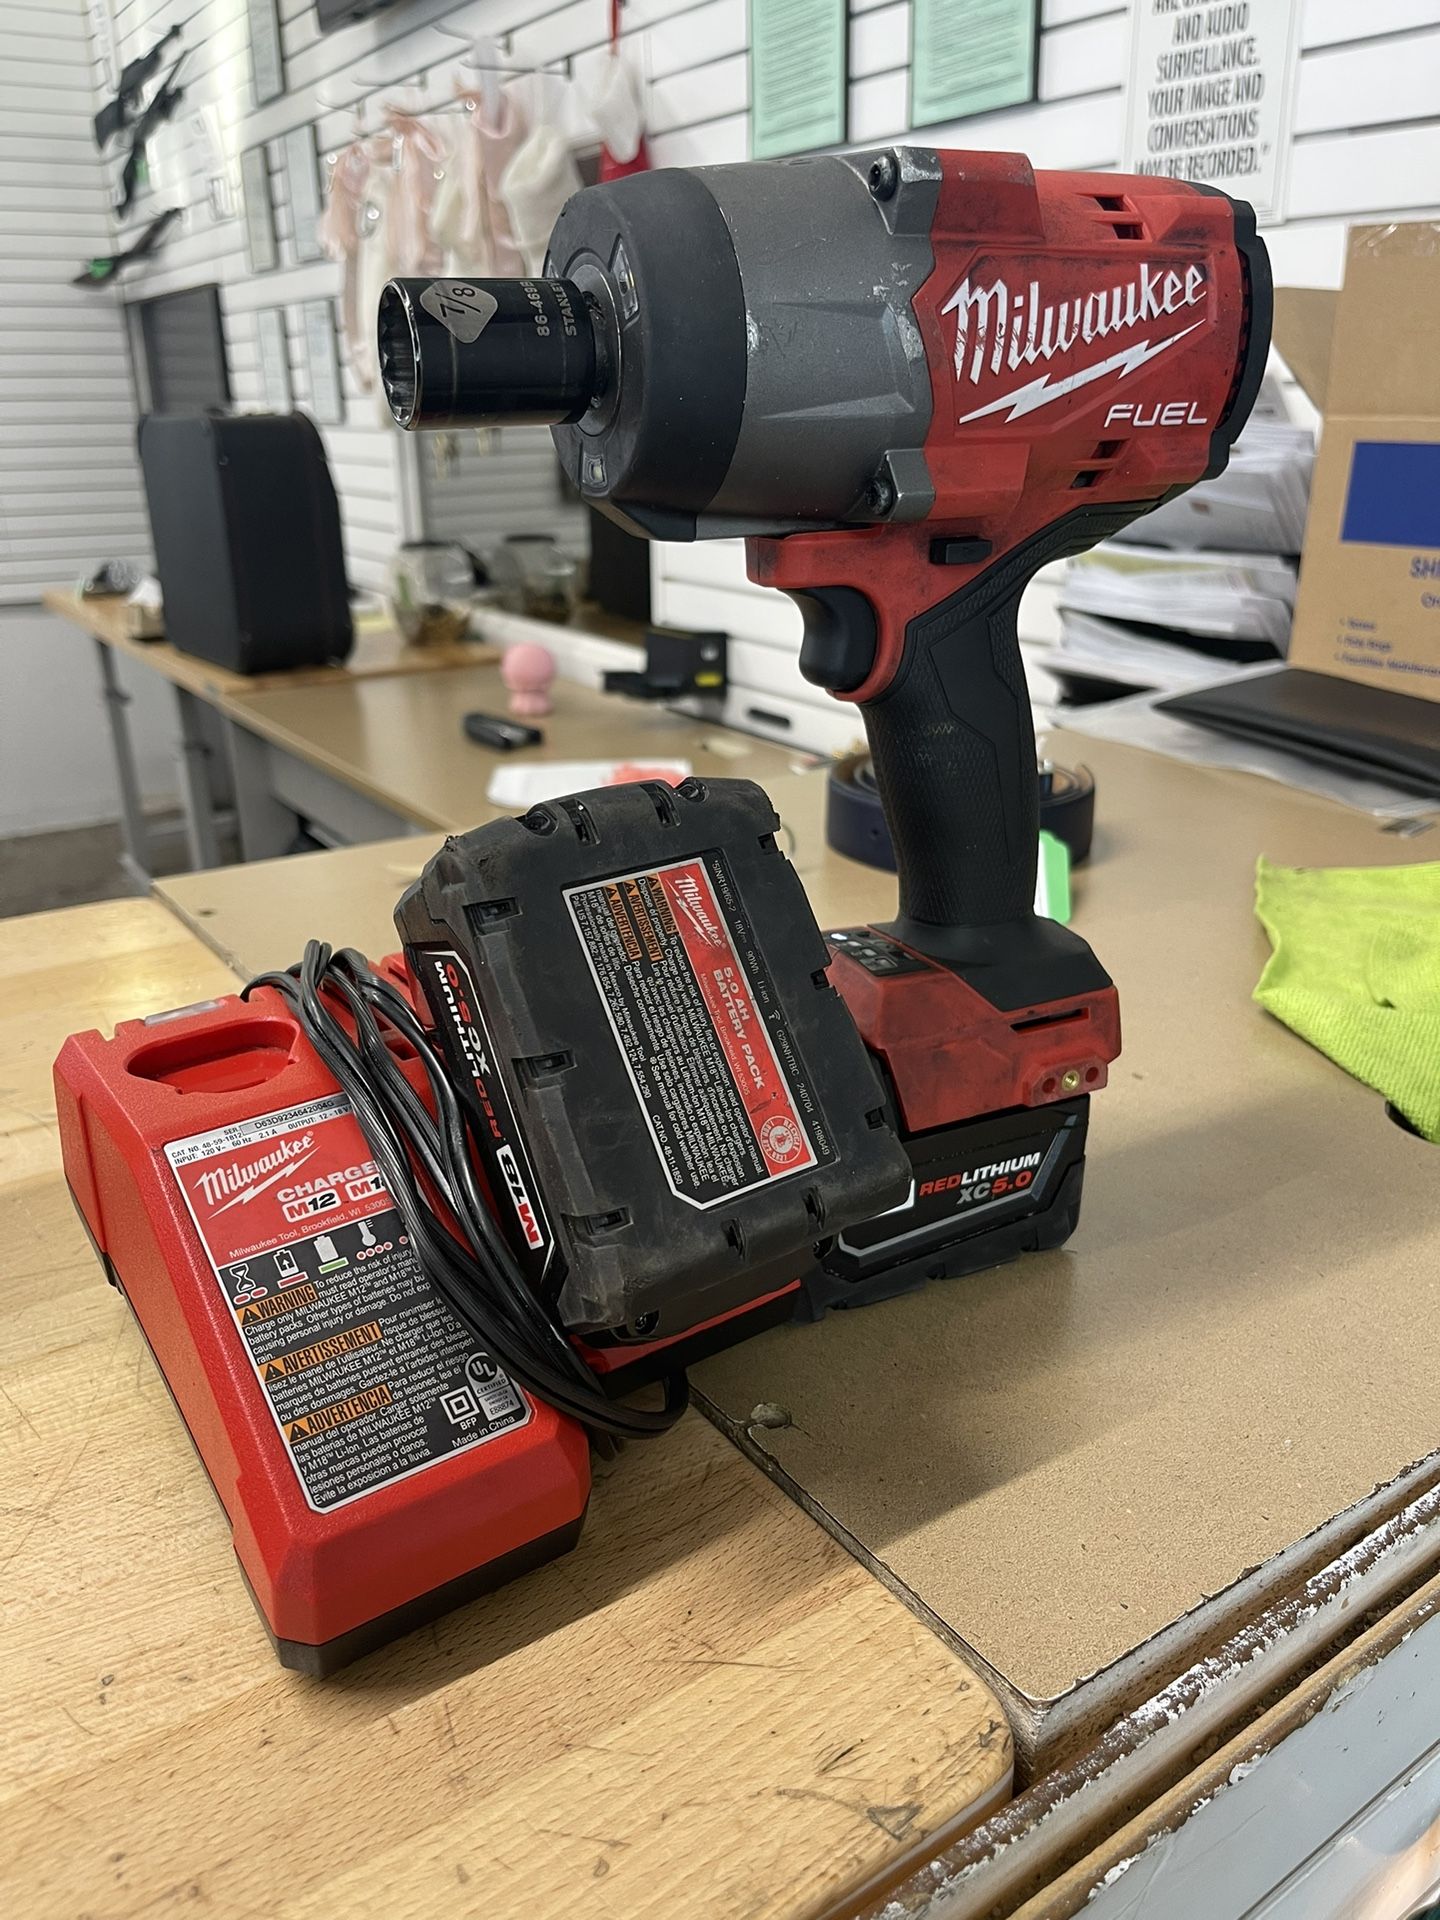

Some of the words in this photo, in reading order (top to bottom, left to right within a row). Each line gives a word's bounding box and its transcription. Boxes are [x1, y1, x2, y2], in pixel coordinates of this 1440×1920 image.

[1187, 78, 1231, 112] IMAGE
[1148, 109, 1259, 153] CONVERSATIONS
[435, 286, 481, 318] 7/8
[550, 281, 577, 336] STANLEY
[941, 263, 1207, 385] Milwaukee
[1104, 402, 1207, 428] FUEL
[610, 898, 640, 957] ADVERTENCIA
[628, 893, 661, 959] AVERTISSEMENT
[651, 887, 676, 932] WARNING
[669, 935, 677, 944] To
[673, 945, 686, 970] reduce
[682, 971, 691, 983] the
[687, 984, 698, 997] risk
[723, 966, 739, 993] 5.0
[734, 997, 749, 1020] AH
[446, 963, 492, 1078] XC5.0
[638, 878, 652, 907] Dispose
[649, 908, 658, 916] of
[664, 948, 678, 975] Charge
[674, 976, 684, 992] only
[680, 992, 692, 1007] with
[686, 1008, 710, 1056] MILWAUKEE
[713, 1080, 733, 1121] Lithium-Ion
[729, 1122, 745, 1158] chargers.
[692, 998, 701, 1006] of
[704, 1029, 712, 1041] fire
[709, 1042, 716, 1050] or
[712, 969, 746, 1040] BATTERY
[741, 1043, 764, 1088] PACK
[434, 960, 503, 1140] REDLITHIUM
[726, 1089, 739, 1106] read
[651, 1064, 661, 1081] See
[657, 1082, 674, 1110] manual
[668, 1110, 676, 1121] for
[672, 1122, 684, 1138] cold
[678, 1139, 694, 1170] weather
[690, 1171, 700, 1189] use.
[733, 1107, 751, 1144] operator's
[662, 1144, 683, 1185] 48-11-1850
[747, 1145, 763, 1175] manual.
[919, 1151, 1041, 1197] REDLITHIUM
[276, 1160, 379, 1203] CHARGE
[286, 1191, 338, 1218] M12
[350, 1176, 385, 1197] M1
[501, 1153, 540, 1246] M18
[957, 1170, 1032, 1204] XC5.0
[229, 1236, 277, 1258] Milwaukee
[348, 1207, 361, 1216] WI
[313, 1280, 324, 1289] To
[325, 1270, 352, 1284] reduce
[352, 1265, 366, 1274] the
[367, 1258, 381, 1269] risk
[382, 1255, 391, 1264] of
[318, 1284, 338, 1297] must
[339, 1277, 357, 1289] read
[358, 1264, 396, 1283] operator's
[244, 1320, 276, 1335] Charge
[277, 1312, 295, 1324] only
[294, 1291, 347, 1316] MILWAUKEE
[373, 1276, 388, 1287] and
[248, 1330, 278, 1345] battery
[279, 1320, 306, 1335] packs.
[305, 1310, 331, 1323] Other
[330, 1301, 352, 1314] types
[353, 1296, 361, 1305] of
[361, 1285, 395, 1301] batteries
[396, 1278, 414, 1289] may
[252, 1338, 285, 1354] causing
[286, 1322, 321, 1343] personal
[321, 1315, 344, 1328] injury
[344, 1311, 354, 1319] or
[388, 1293, 402, 1302] Do
[402, 1286, 416, 1297] not
[256, 1285, 315, 1318] WARNING
[256, 1352, 275, 1364] rain.
[280, 1323, 380, 1373] AVERTISSEMENT
[471, 1361, 495, 1377] UL
[476, 1378, 506, 1394] CERTIFIED
[305, 1386, 390, 1433] ADVERTENCIA
[459, 1416, 478, 1430] BFP
[451, 1431, 478, 1447] Made
[477, 1427, 488, 1435] in
[487, 1415, 515, 1431] China
[313, 1489, 336, 1504] Evite
[336, 1485, 346, 1494] la
[347, 1466, 391, 1489] exposicion
[392, 1462, 398, 1470] a
[399, 1458, 408, 1466] la
[408, 1448, 432, 1462] lluvia.
